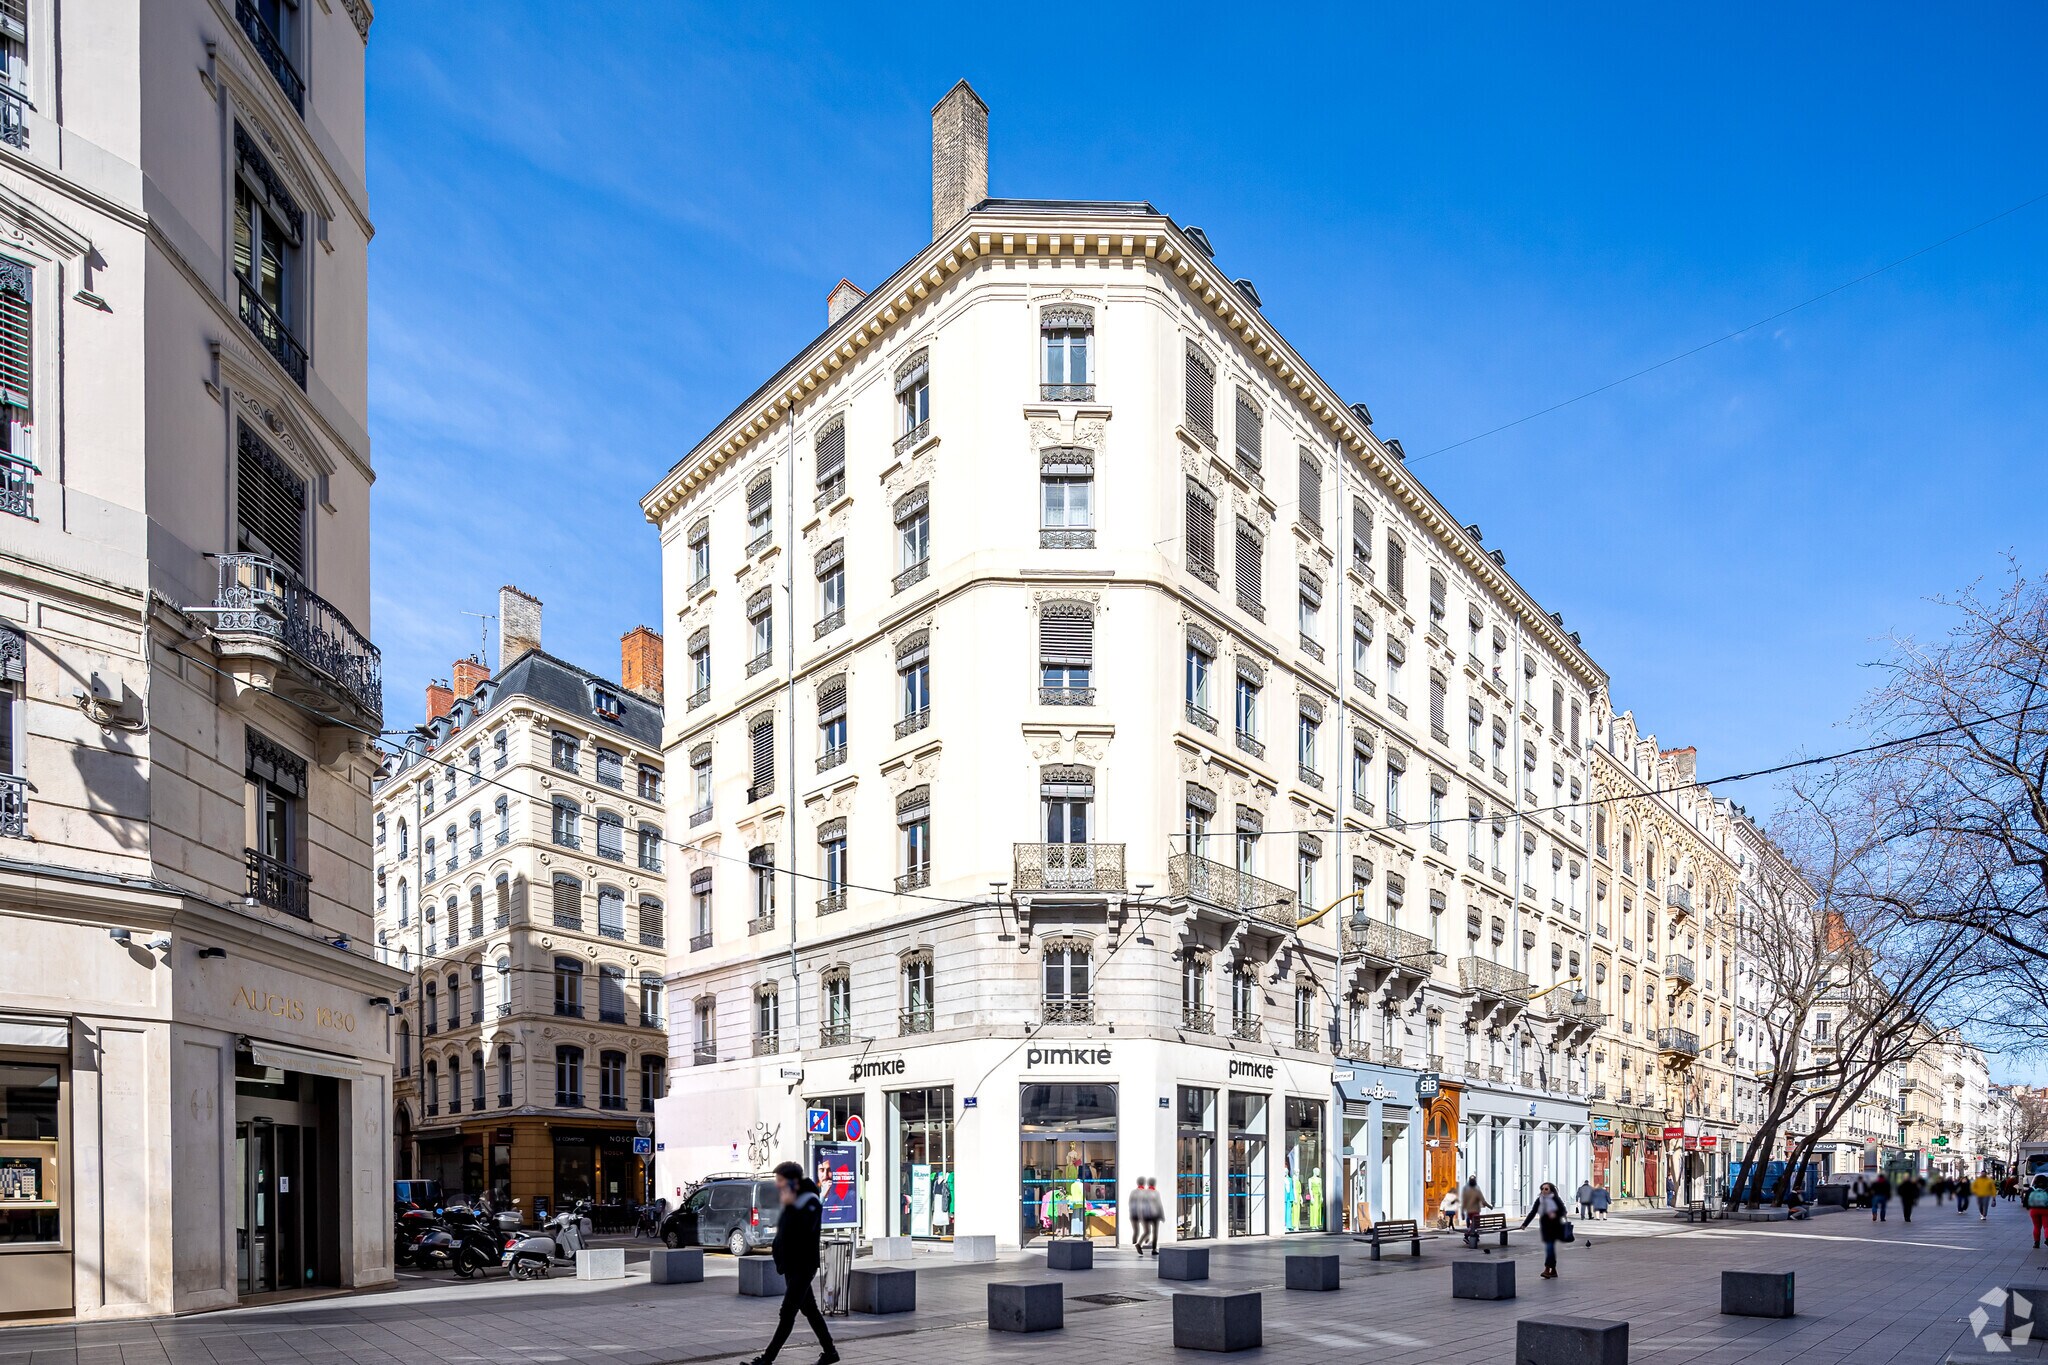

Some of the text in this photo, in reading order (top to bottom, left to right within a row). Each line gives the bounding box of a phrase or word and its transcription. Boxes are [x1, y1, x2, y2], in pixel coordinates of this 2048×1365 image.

[233, 986, 355, 1032] AUGIS 1830
[1027, 1049, 1112, 1069] pimkie
[1229, 1060, 1274, 1078] pimkie
[853, 1060, 905, 1082] pimkie
